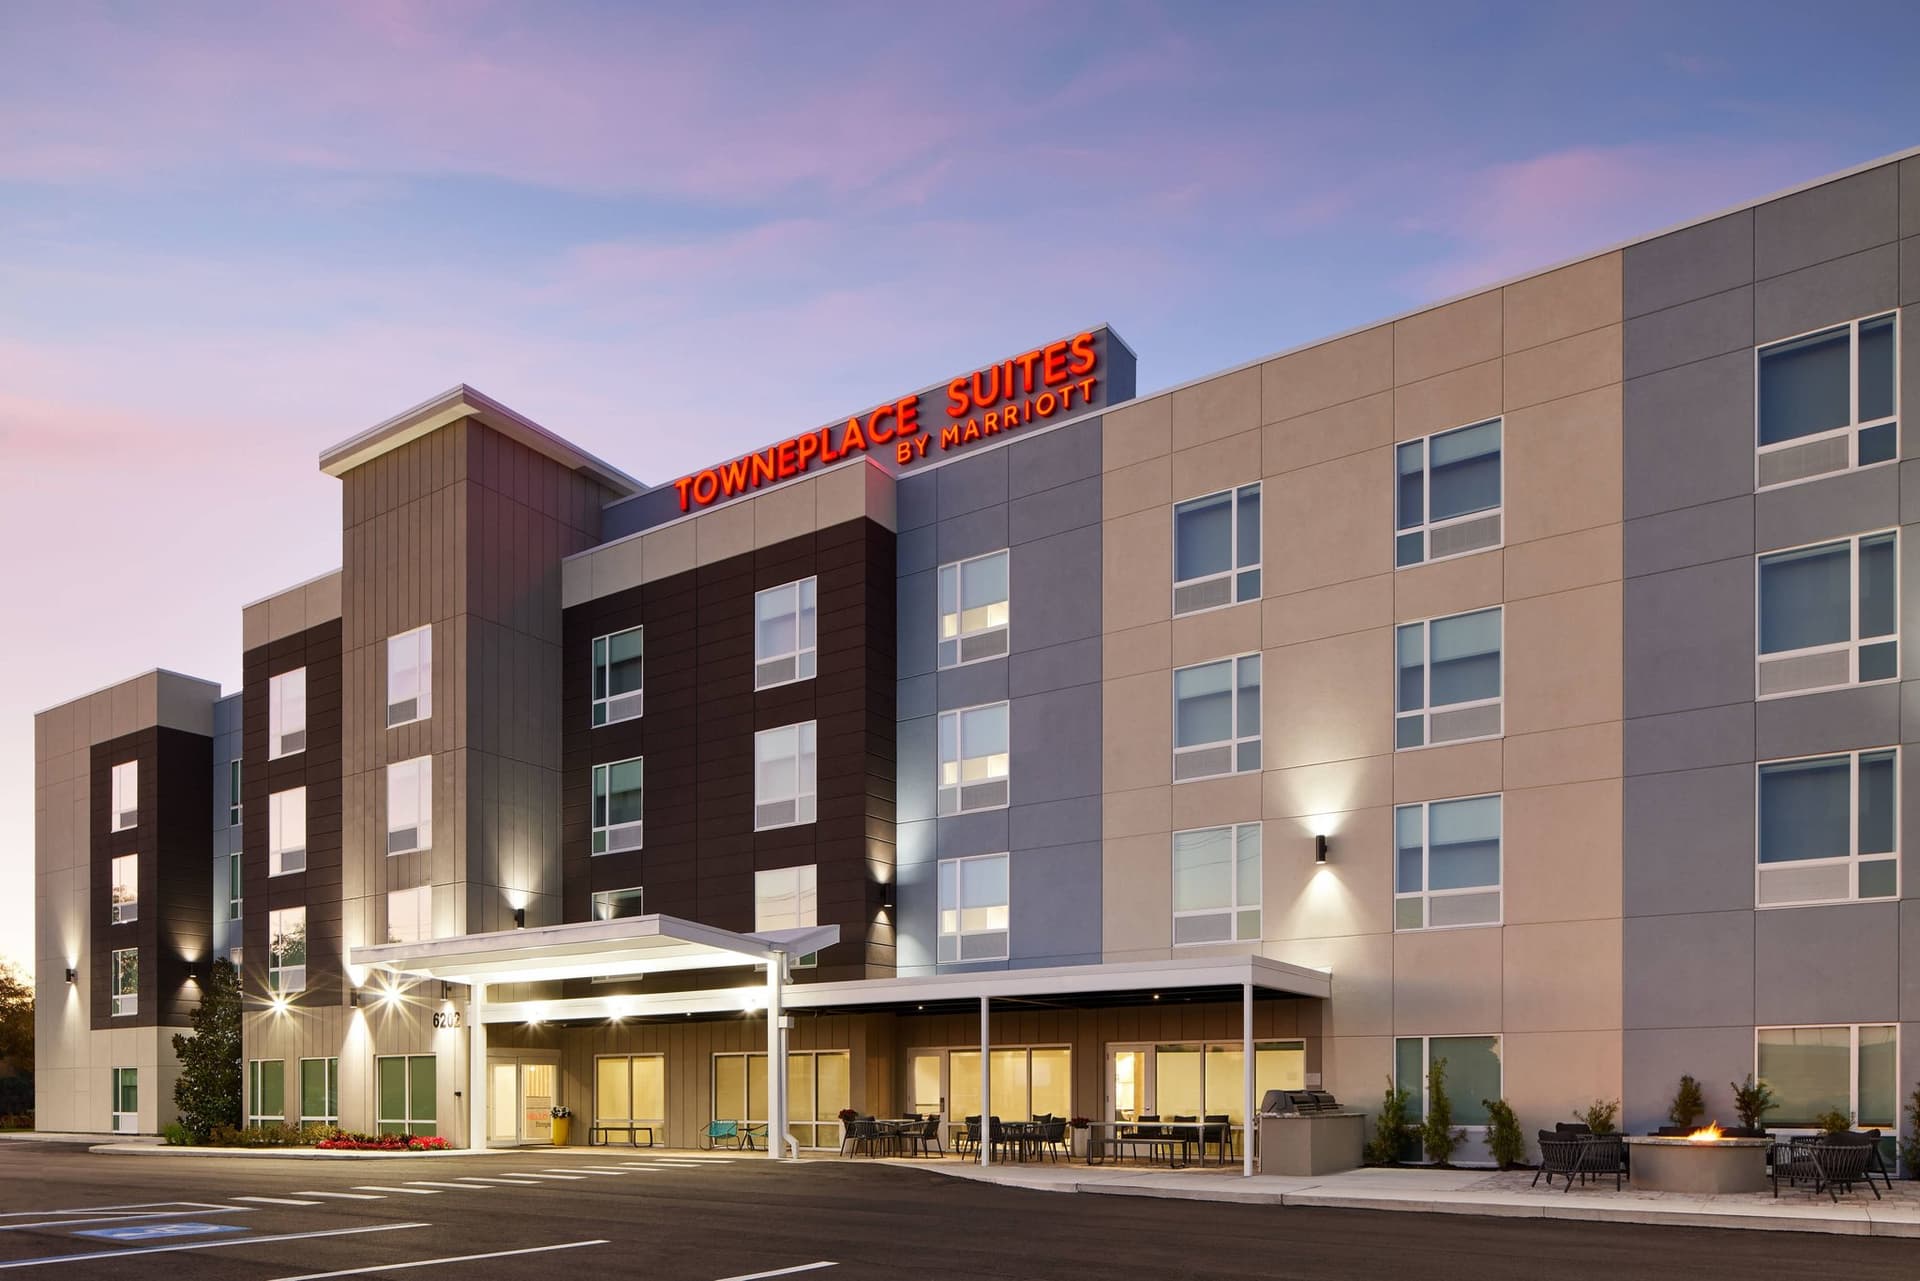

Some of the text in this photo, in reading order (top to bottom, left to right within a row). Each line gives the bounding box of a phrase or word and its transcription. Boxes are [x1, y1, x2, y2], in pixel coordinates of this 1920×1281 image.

[674, 332, 1097, 513] TOWNEPLACE SUITES
[896, 378, 1097, 465] BY MARRIOTT
[433, 1012, 461, 1028] 6202
